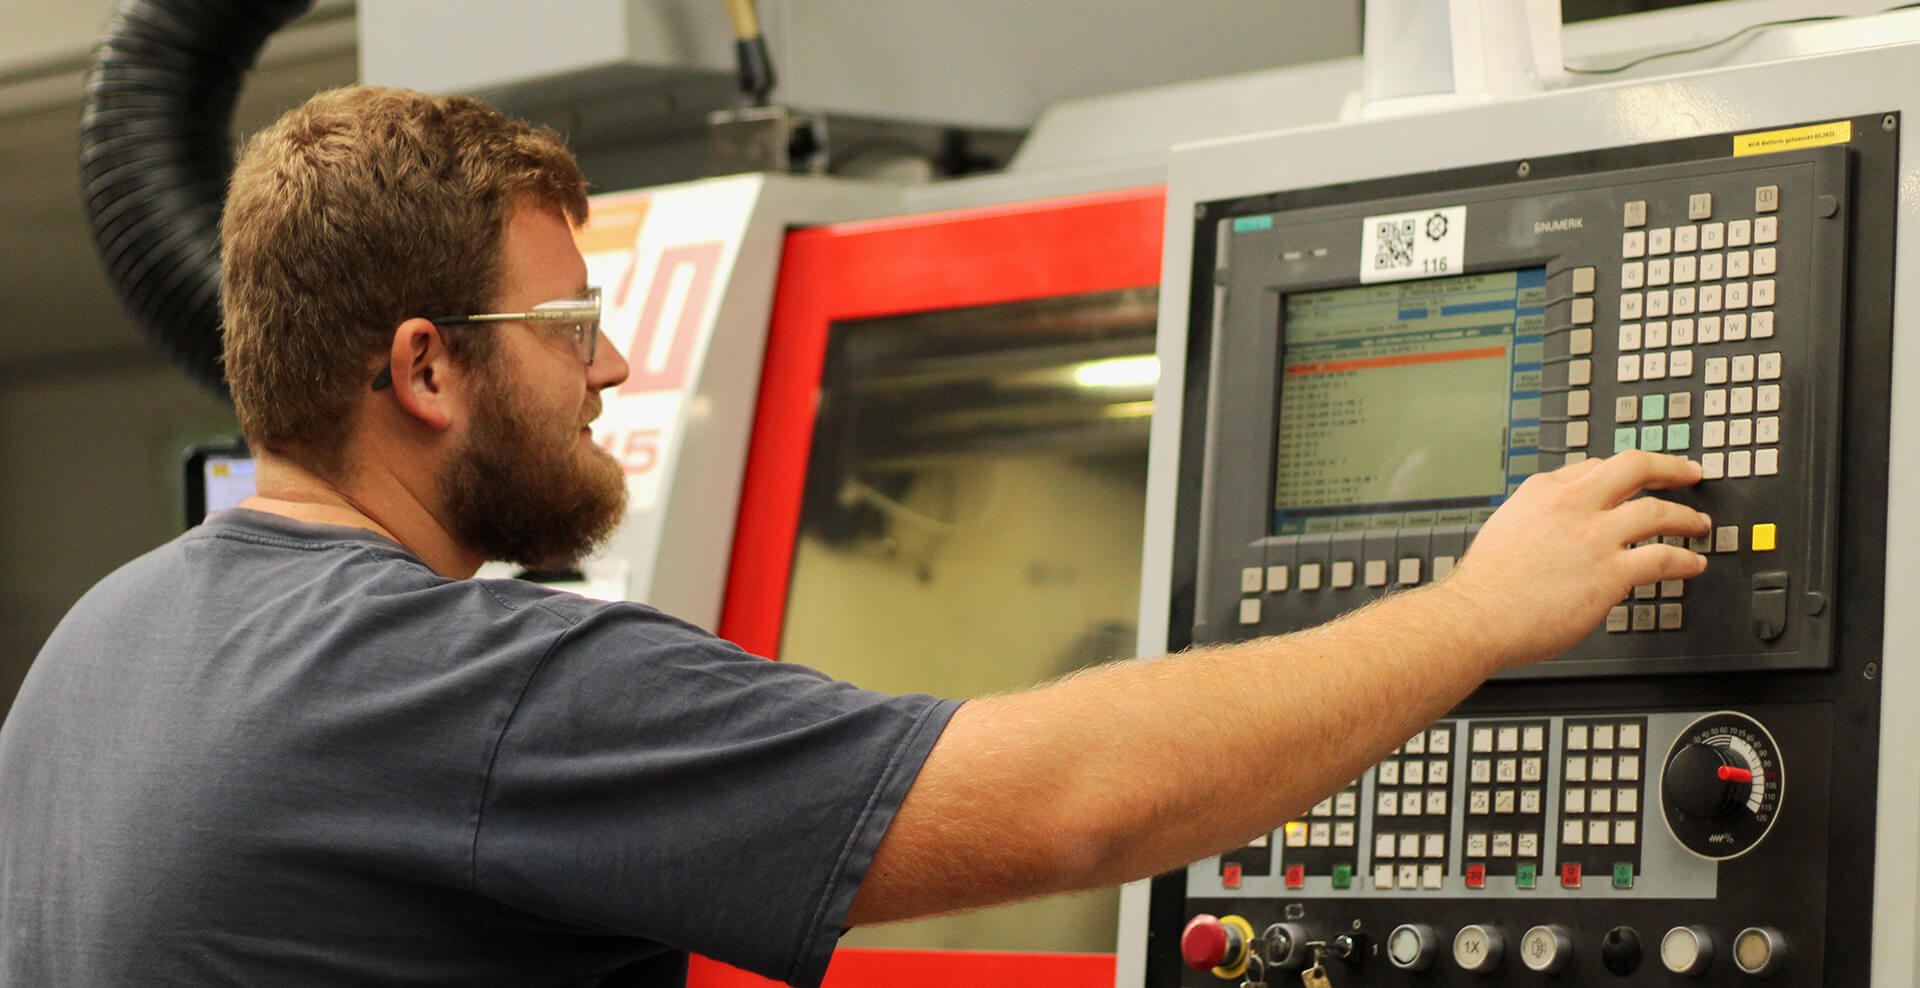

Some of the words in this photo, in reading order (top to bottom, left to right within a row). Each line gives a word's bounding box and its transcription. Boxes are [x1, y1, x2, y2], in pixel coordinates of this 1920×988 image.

[1533, 217, 1584, 234] SINUMERIK
[1423, 256, 1448, 274] 116
[1720, 726, 1728, 734] 60
[1761, 803, 1772, 811] 115
[1756, 814, 1767, 822] 120
[1464, 940, 1481, 955] 1X
